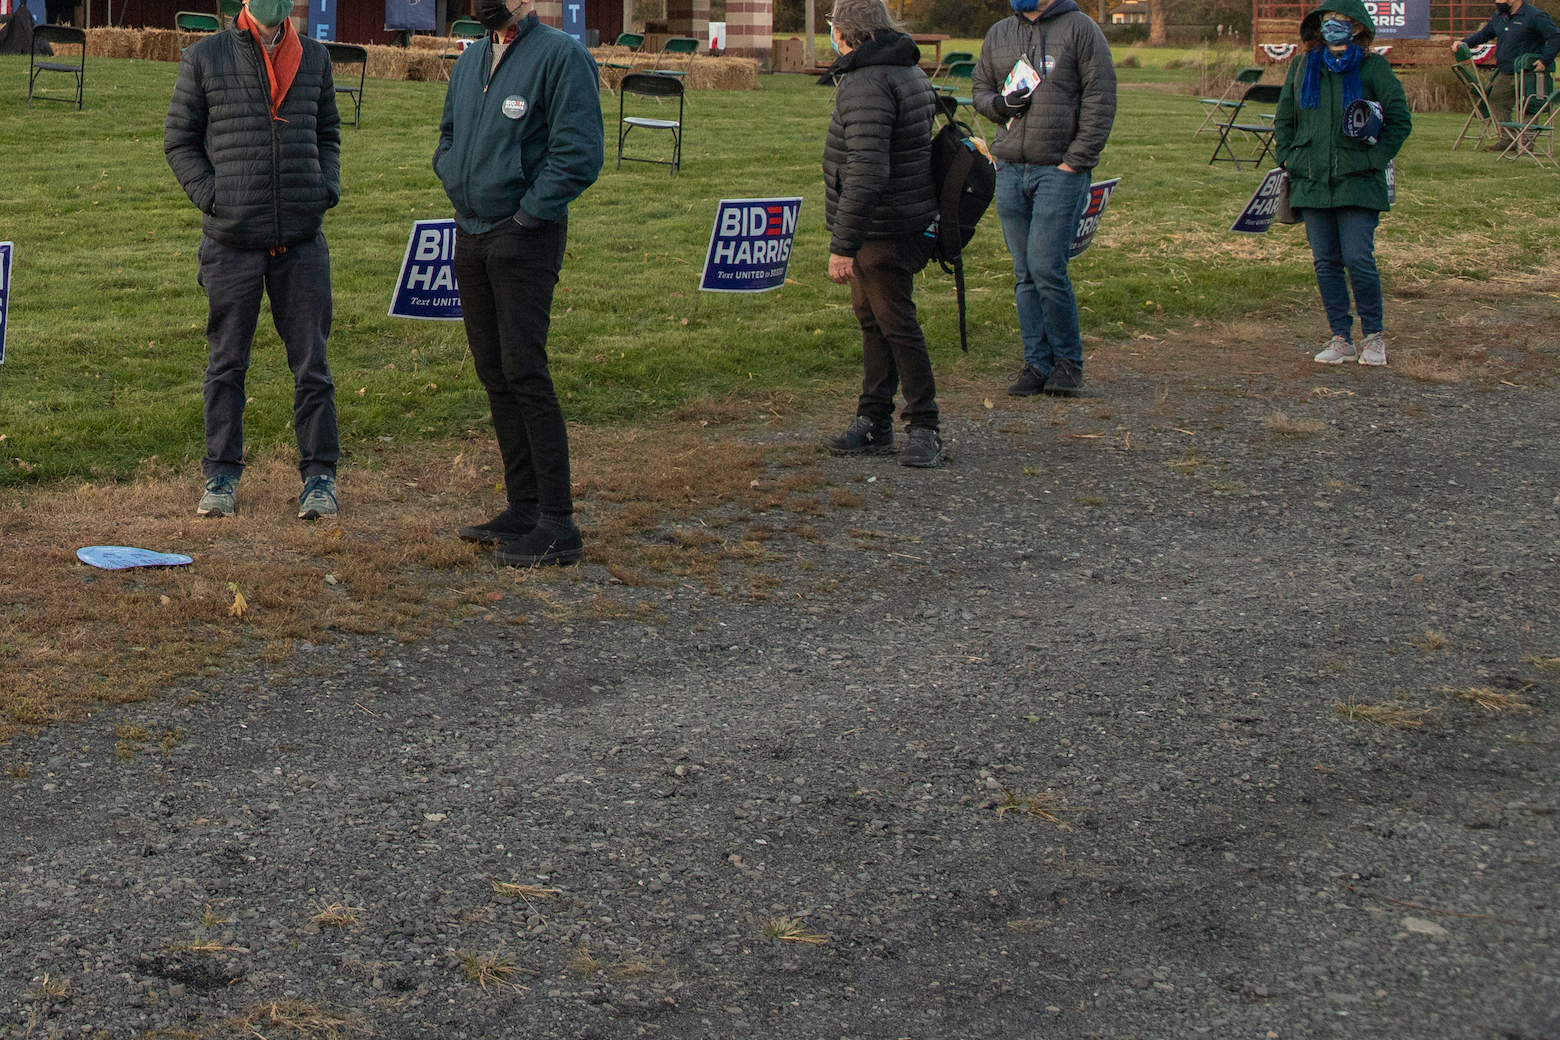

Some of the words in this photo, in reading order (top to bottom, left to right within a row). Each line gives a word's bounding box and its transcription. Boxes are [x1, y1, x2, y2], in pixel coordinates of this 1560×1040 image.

[1363, 2, 1406, 15] DEN
[1370, 15, 1406, 27] RRIS
[1247, 197, 1280, 216] HAR
[719, 205, 797, 237] BIDEN
[713, 238, 792, 265] HARRIS
[717, 270, 734, 279] Text
[735, 270, 765, 279] UNITED
[410, 296, 431, 306] Text
[432, 297, 462, 307] UNITE
